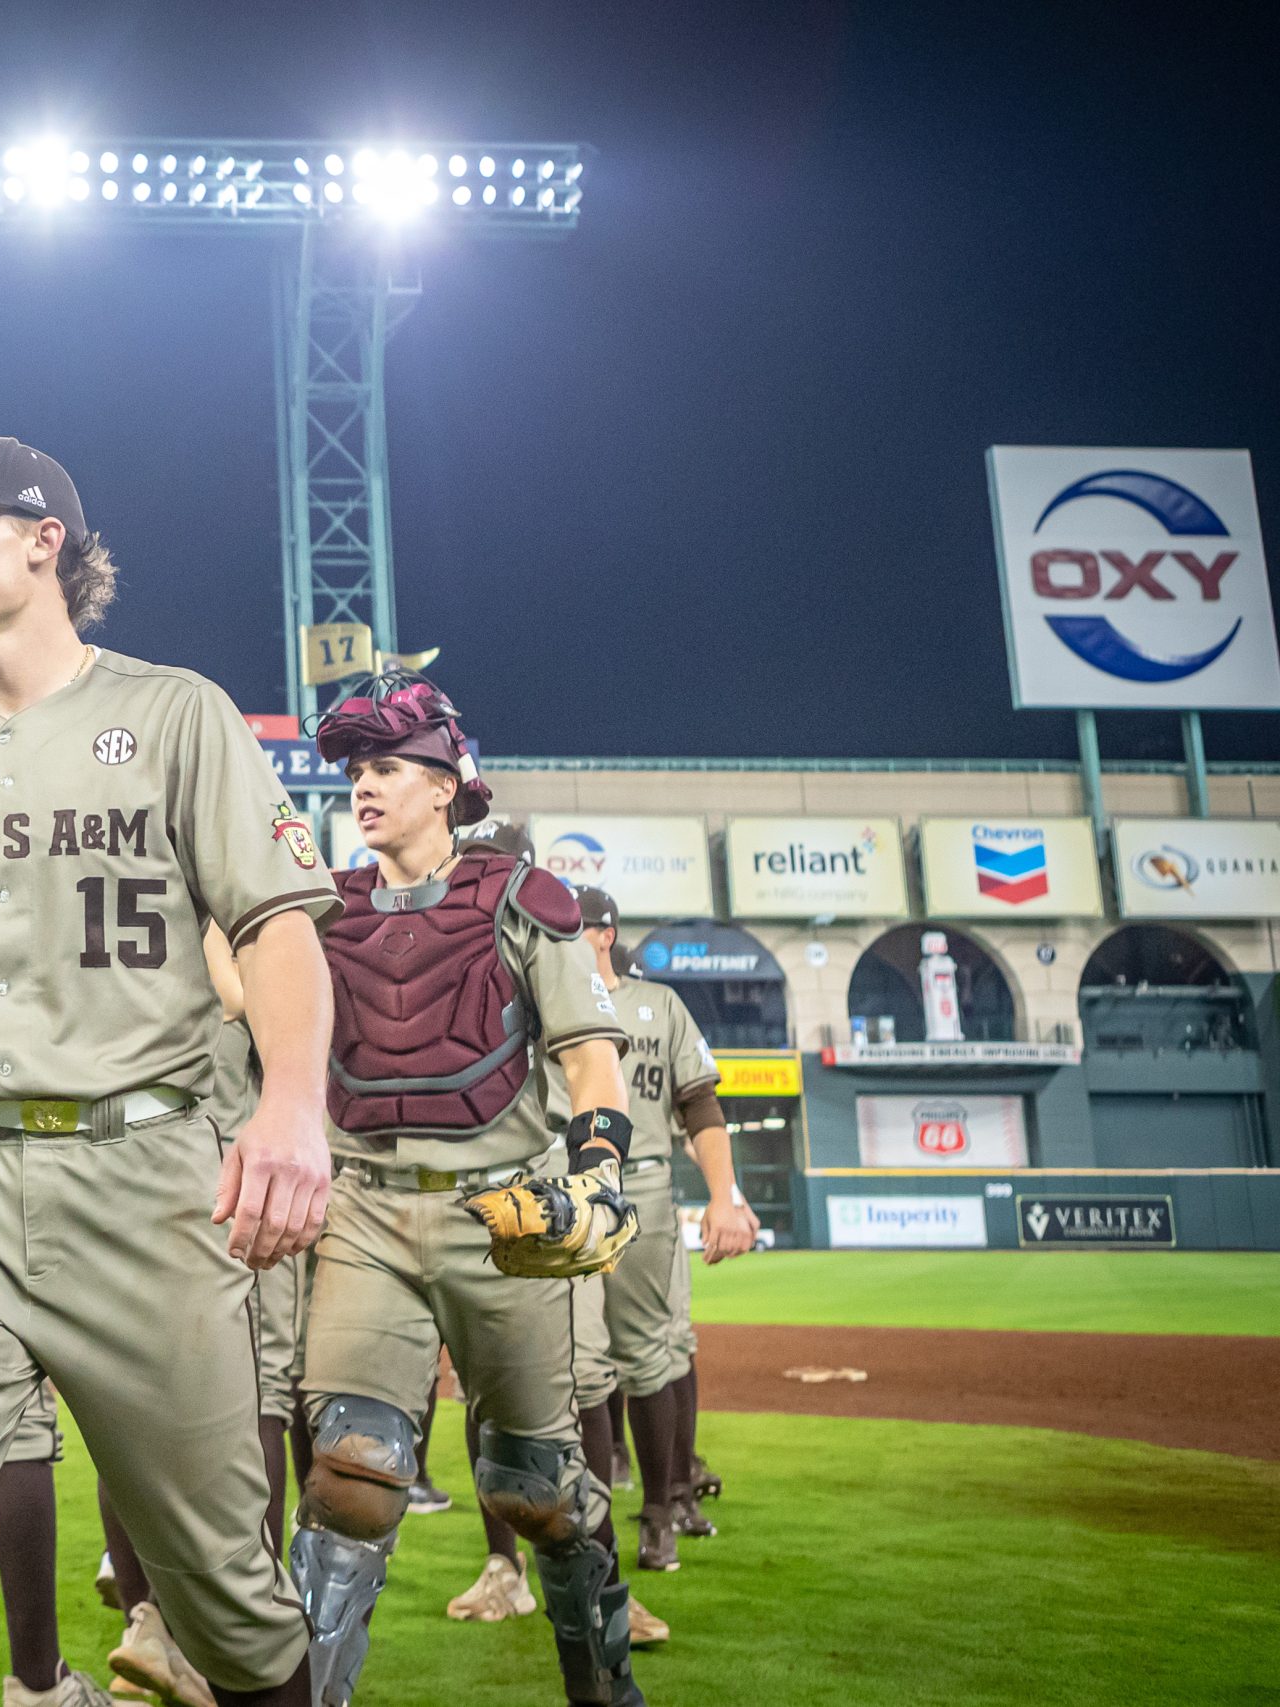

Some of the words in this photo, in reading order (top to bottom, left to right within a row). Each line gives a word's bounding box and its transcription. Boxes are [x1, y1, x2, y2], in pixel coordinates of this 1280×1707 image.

[17, 493, 47, 509] adidas
[1030, 548, 1240, 602] OXY
[319, 635, 354, 666] 17
[95, 729, 135, 765] SEC
[49, 808, 148, 857] A&M
[972, 824, 1043, 841] Chevron
[547, 855, 606, 874] OXY
[753, 844, 867, 875] reliant
[1206, 857, 1279, 874] QUANTA
[76, 876, 167, 969] 15
[631, 1062, 664, 1101] 49
[924, 1124, 958, 1149] 66
[867, 1204, 959, 1228] Insperity
[1055, 1207, 1161, 1229] VERITEX
